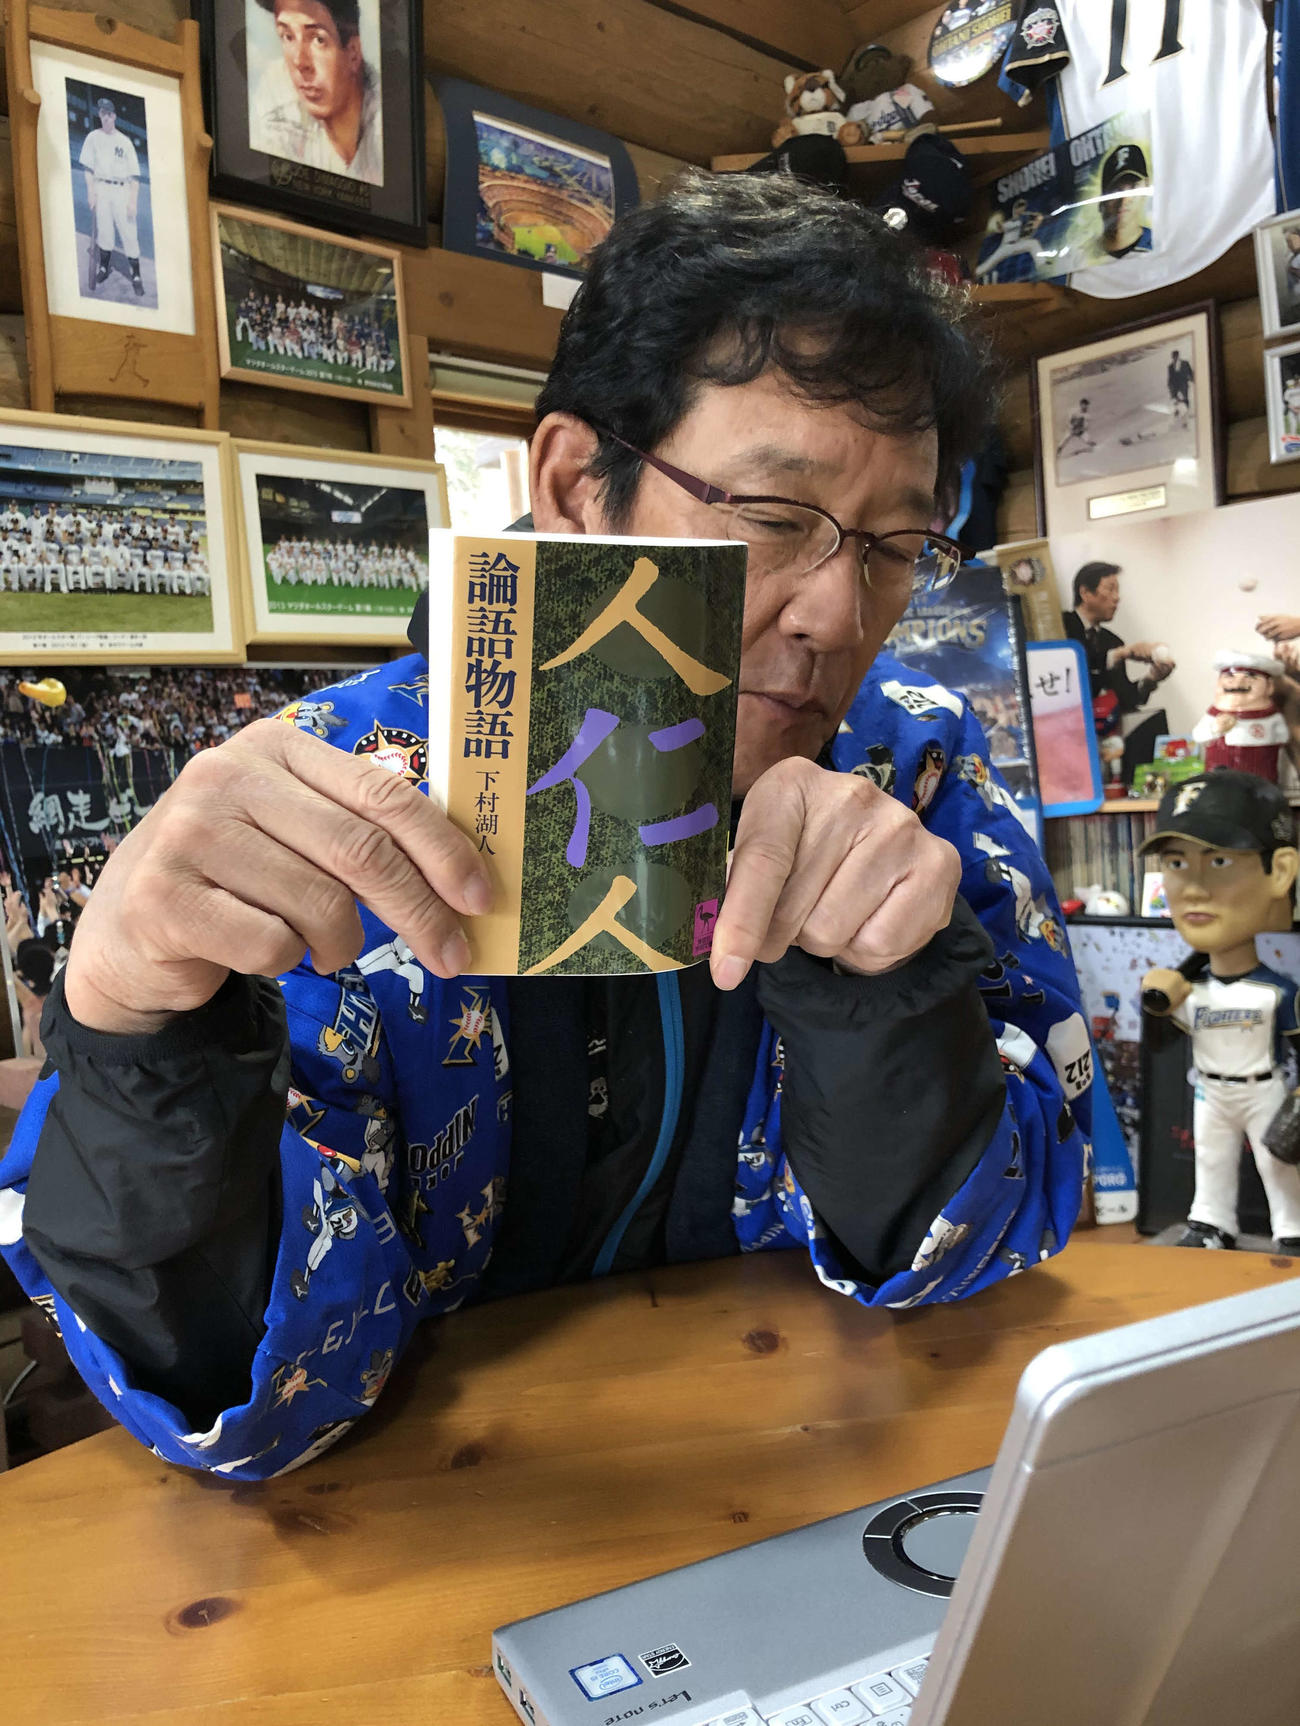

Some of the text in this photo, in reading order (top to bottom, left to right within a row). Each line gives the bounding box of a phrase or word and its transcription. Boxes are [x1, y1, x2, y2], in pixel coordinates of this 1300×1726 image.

[463, 552, 520, 759] 論語物語
[475, 771, 500, 856] 下村湖人
[830, 1700, 850, 1712] Ctrl
